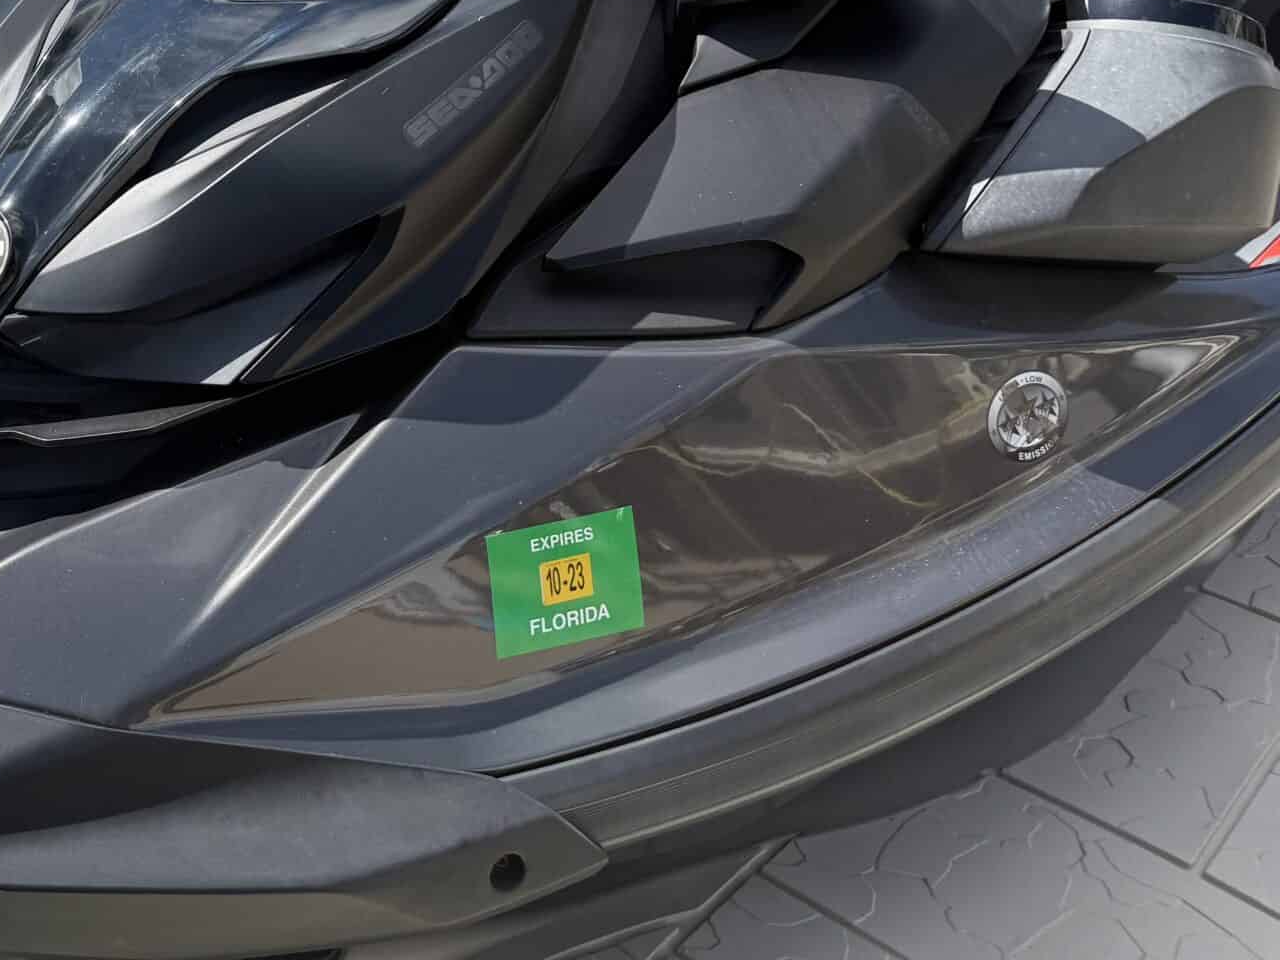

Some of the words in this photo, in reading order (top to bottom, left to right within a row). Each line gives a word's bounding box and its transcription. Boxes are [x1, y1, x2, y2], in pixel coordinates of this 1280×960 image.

[530, 526, 595, 553] EXPIRES
[546, 560, 586, 597] 10-23
[529, 603, 611, 637] FLORIDA
